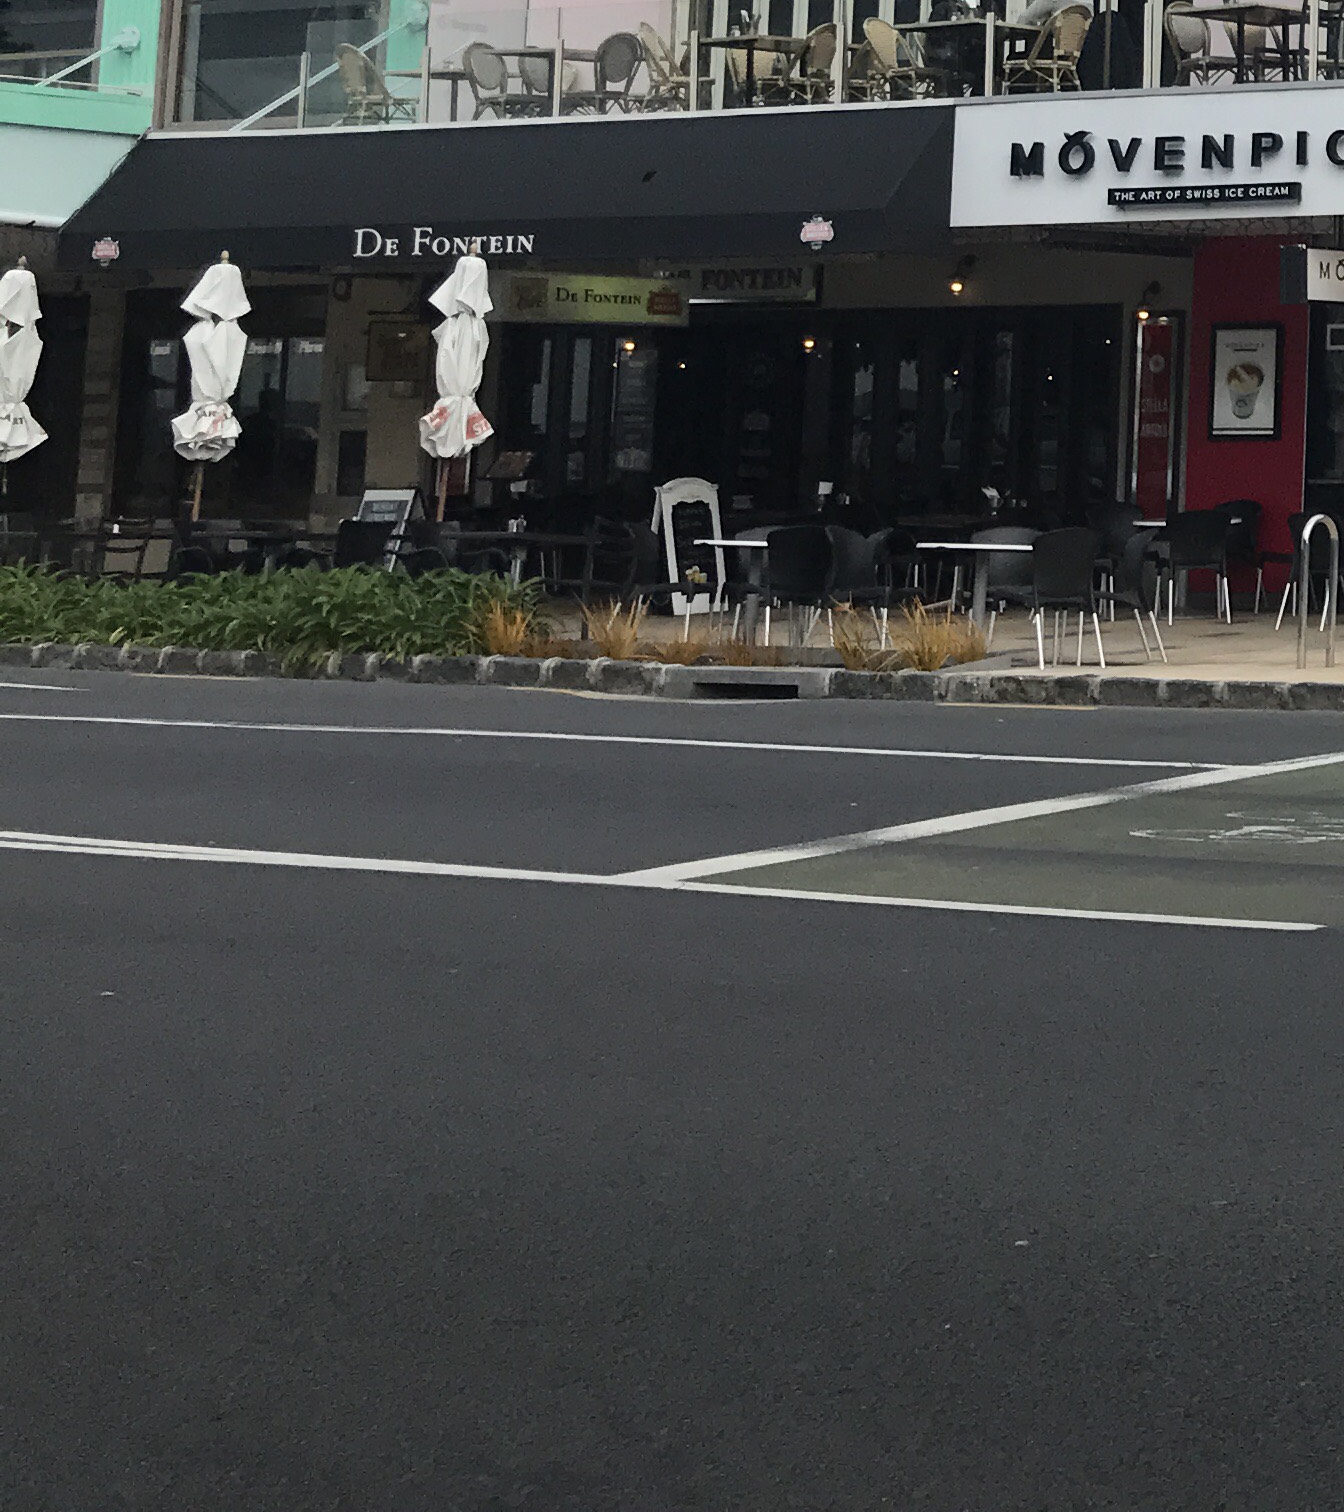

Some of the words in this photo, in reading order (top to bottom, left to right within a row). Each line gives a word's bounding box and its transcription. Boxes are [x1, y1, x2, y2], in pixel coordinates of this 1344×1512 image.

[1113, 190, 1135, 202] THE
[1139, 190, 1162, 201] ART
[1165, 189, 1182, 200] OF
[1185, 188, 1220, 199] SWISS
[1224, 187, 1244, 198] ICE
[1248, 186, 1290, 197] CREAM
[353, 228, 399, 258] DE
[411, 227, 535, 256] FONTEIN
[555, 287, 579, 303] DE
[584, 288, 642, 305] FONTEIN
